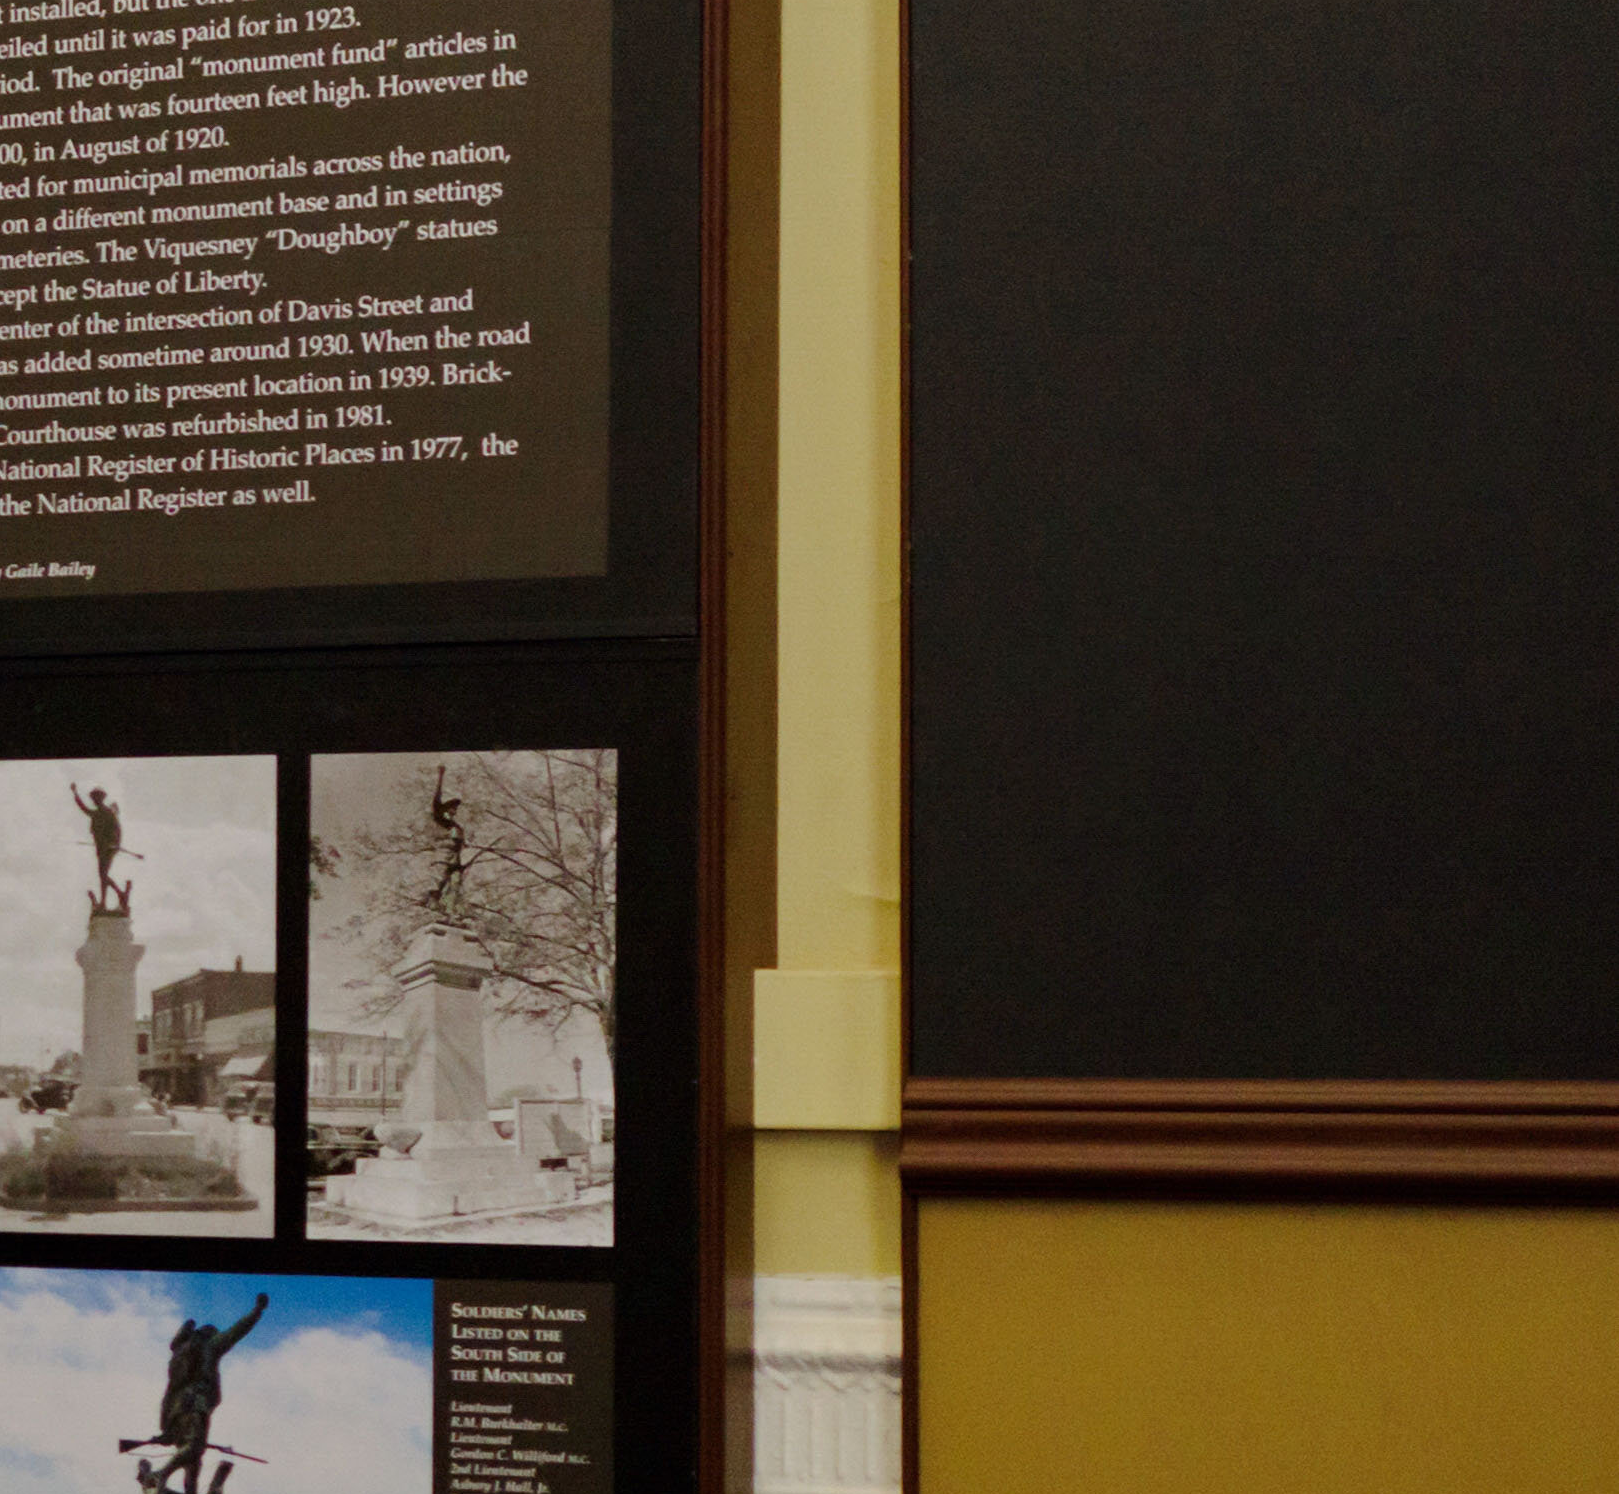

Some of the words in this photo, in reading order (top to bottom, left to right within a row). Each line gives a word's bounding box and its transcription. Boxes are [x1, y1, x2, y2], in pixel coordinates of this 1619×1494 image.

[35, 487, 132, 515] National
[136, 485, 228, 517] Register
[230, 487, 258, 506] as
[260, 478, 317, 504] well.
[3, 561, 46, 579] Gaile
[46, 560, 96, 580] Bailey
